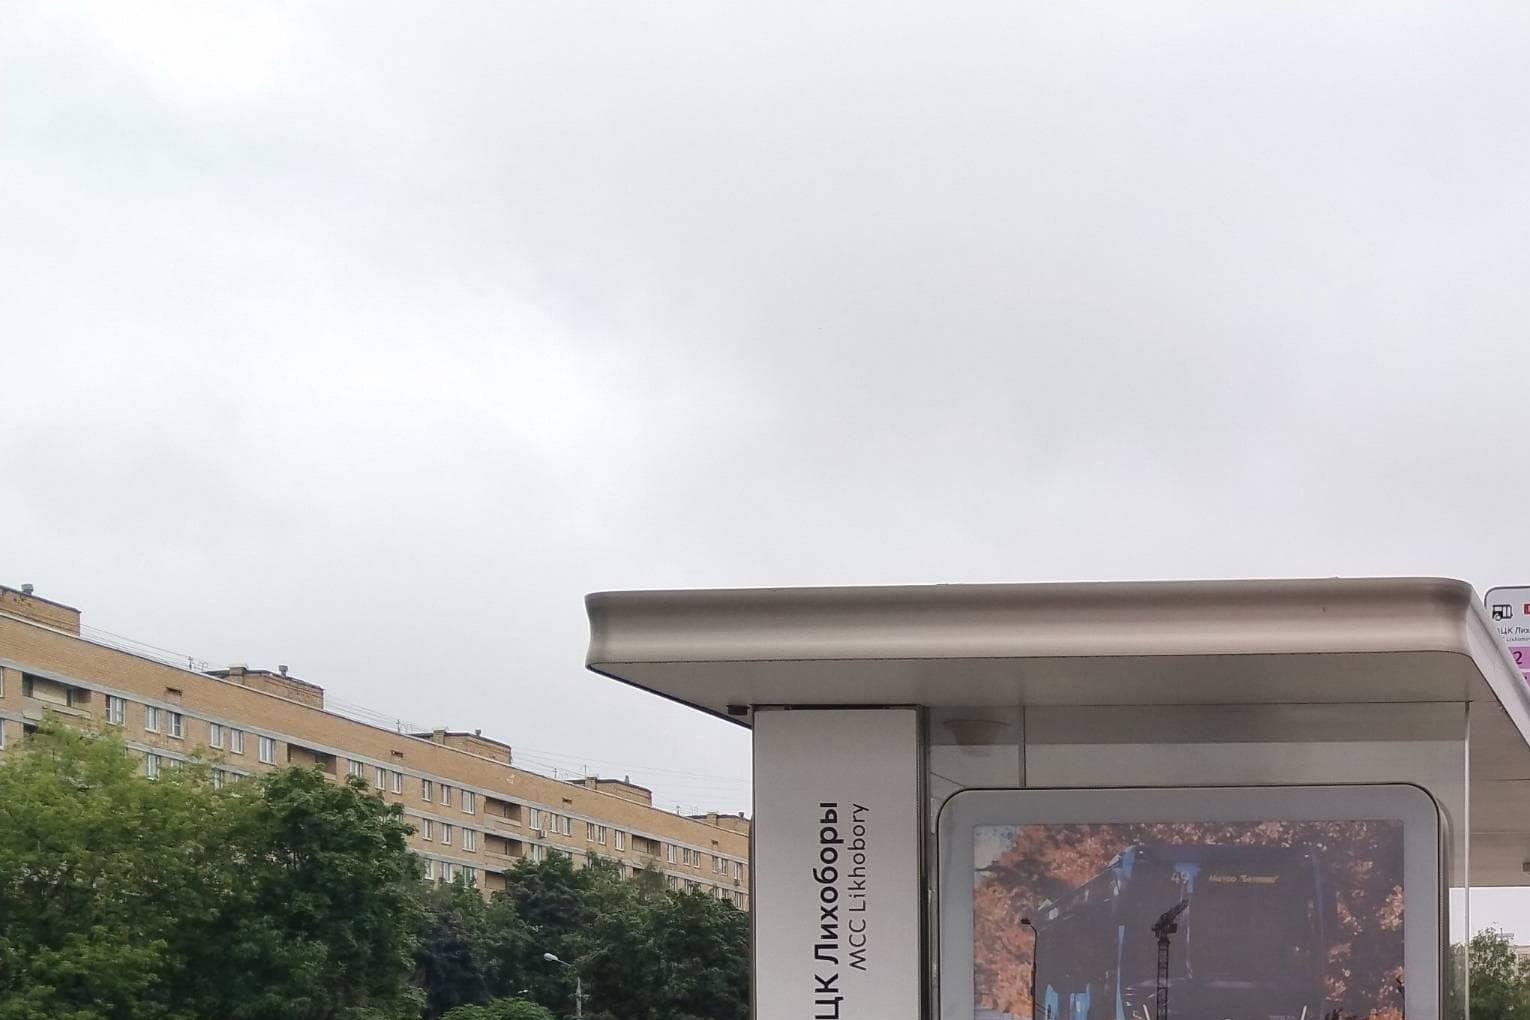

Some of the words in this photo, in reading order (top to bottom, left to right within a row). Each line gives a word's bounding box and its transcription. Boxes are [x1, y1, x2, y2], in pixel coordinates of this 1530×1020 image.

[1513, 650, 1523, 665] 2
[812, 802, 844, 965] Лихоборы
[848, 803, 870, 912] Likhobory
[849, 918, 867, 971] MCC
